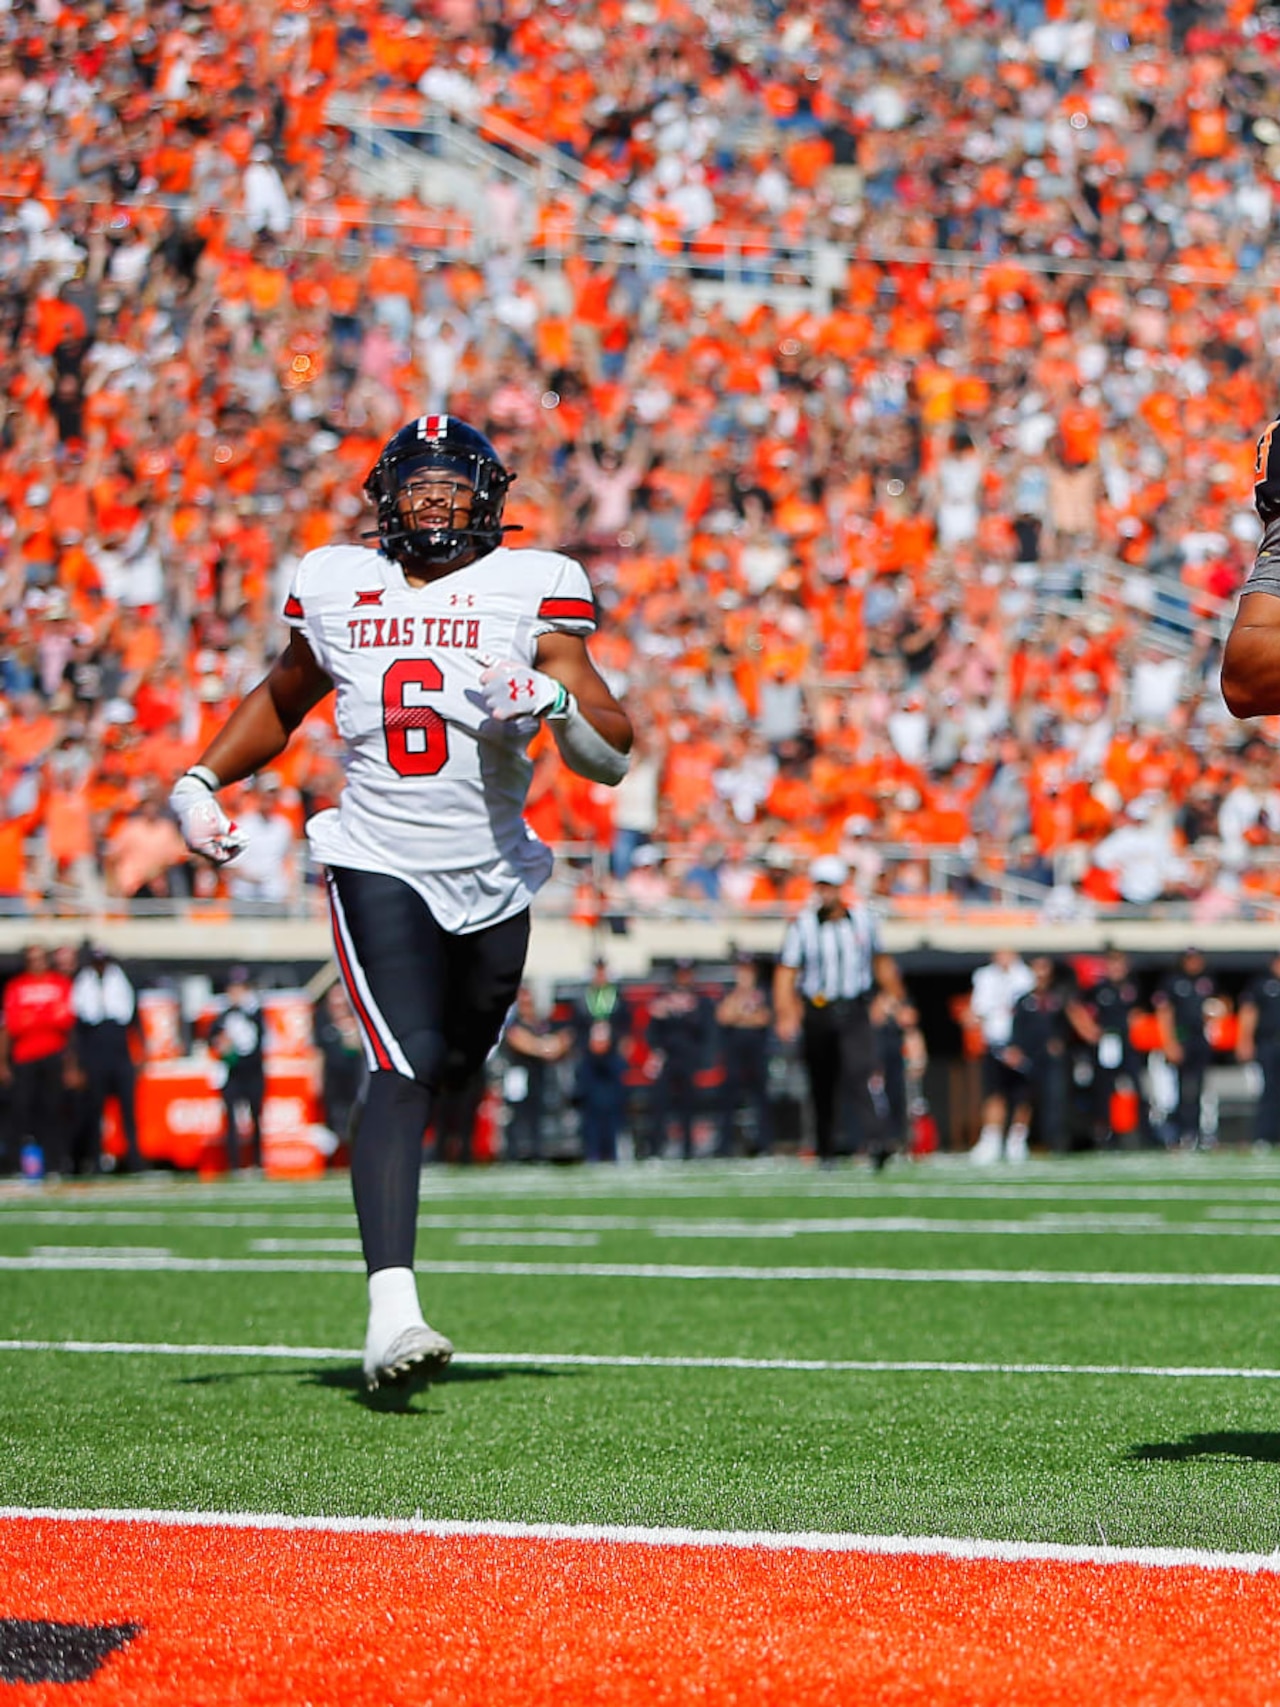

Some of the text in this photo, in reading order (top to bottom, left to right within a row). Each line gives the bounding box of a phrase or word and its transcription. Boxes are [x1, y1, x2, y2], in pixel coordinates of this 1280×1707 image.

[347, 617, 480, 649] TEXAS TECH
[382, 658, 450, 778] 6
